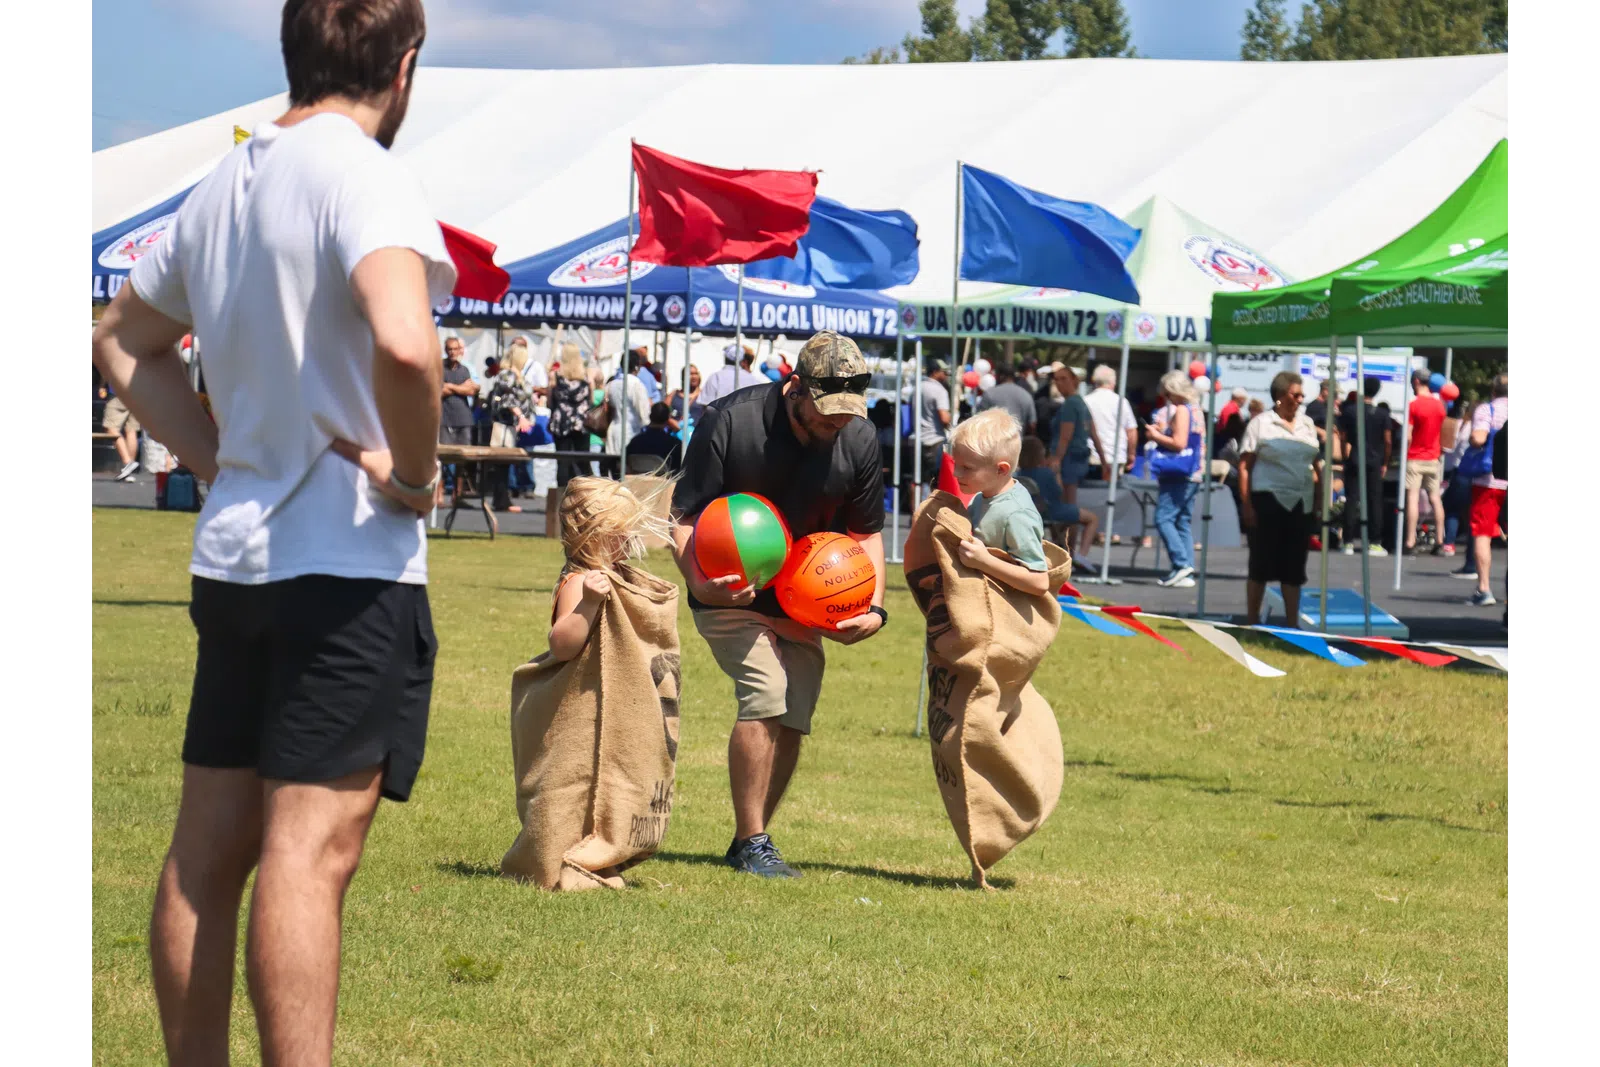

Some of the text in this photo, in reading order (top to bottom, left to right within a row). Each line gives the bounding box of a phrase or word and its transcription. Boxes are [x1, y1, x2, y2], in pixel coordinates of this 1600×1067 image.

[460, 296, 488, 315] UA
[558, 292, 625, 320] UNION
[629, 294, 659, 322] 72
[1404, 282, 1454, 305] HEALTHIER
[1455, 284, 1483, 306] CARE
[720, 299, 899, 336] UA LOCAL UNION 72
[923, 305, 949, 331] UA
[1011, 306, 1069, 335] UNION
[1073, 309, 1098, 337] 72
[1166, 316, 1197, 342] UA
[824, 561, 875, 588] GULATION
